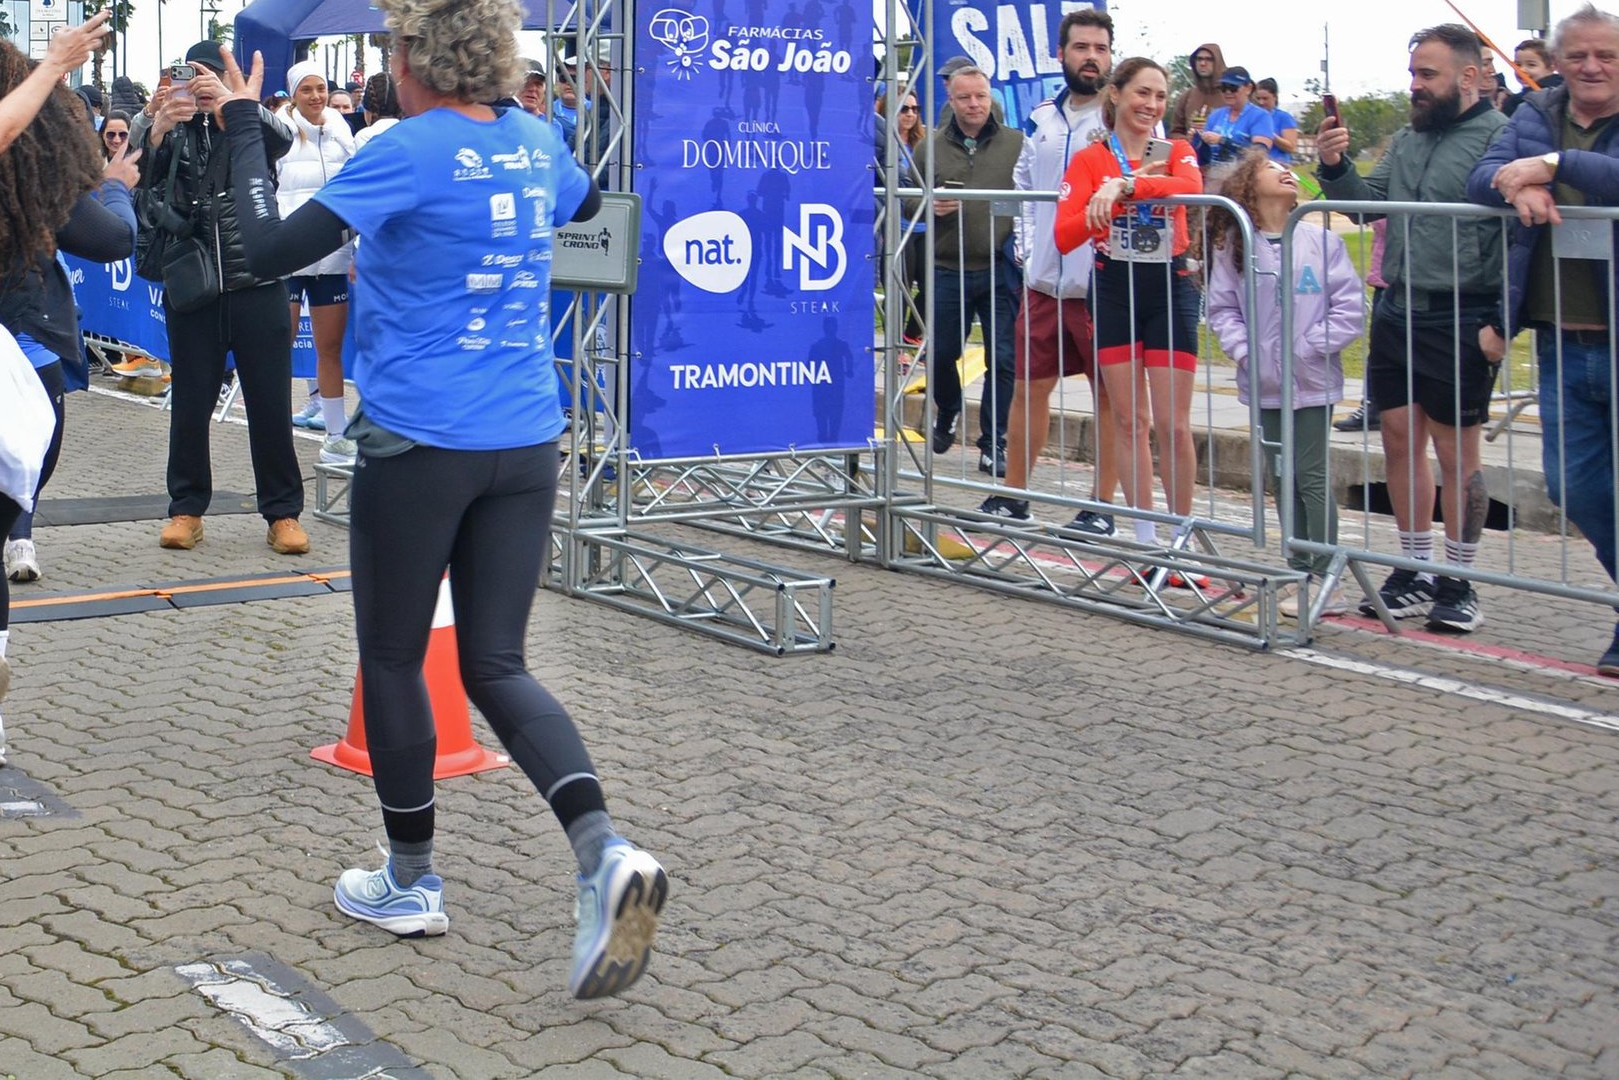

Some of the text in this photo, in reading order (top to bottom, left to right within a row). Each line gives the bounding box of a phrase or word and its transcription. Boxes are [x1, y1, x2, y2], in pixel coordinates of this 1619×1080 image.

[728, 26, 823, 40] FARMÁCIAS
[951, 1, 1094, 81] SAL
[708, 35, 852, 74] São João
[739, 121, 780, 133] CLÍNICA
[682, 139, 831, 174] DOMINIQUE
[557, 231, 598, 241] SPRINT
[1296, 264, 1322, 293] A
[791, 301, 840, 314] STEAK
[669, 360, 832, 390] TRAMONTINA
